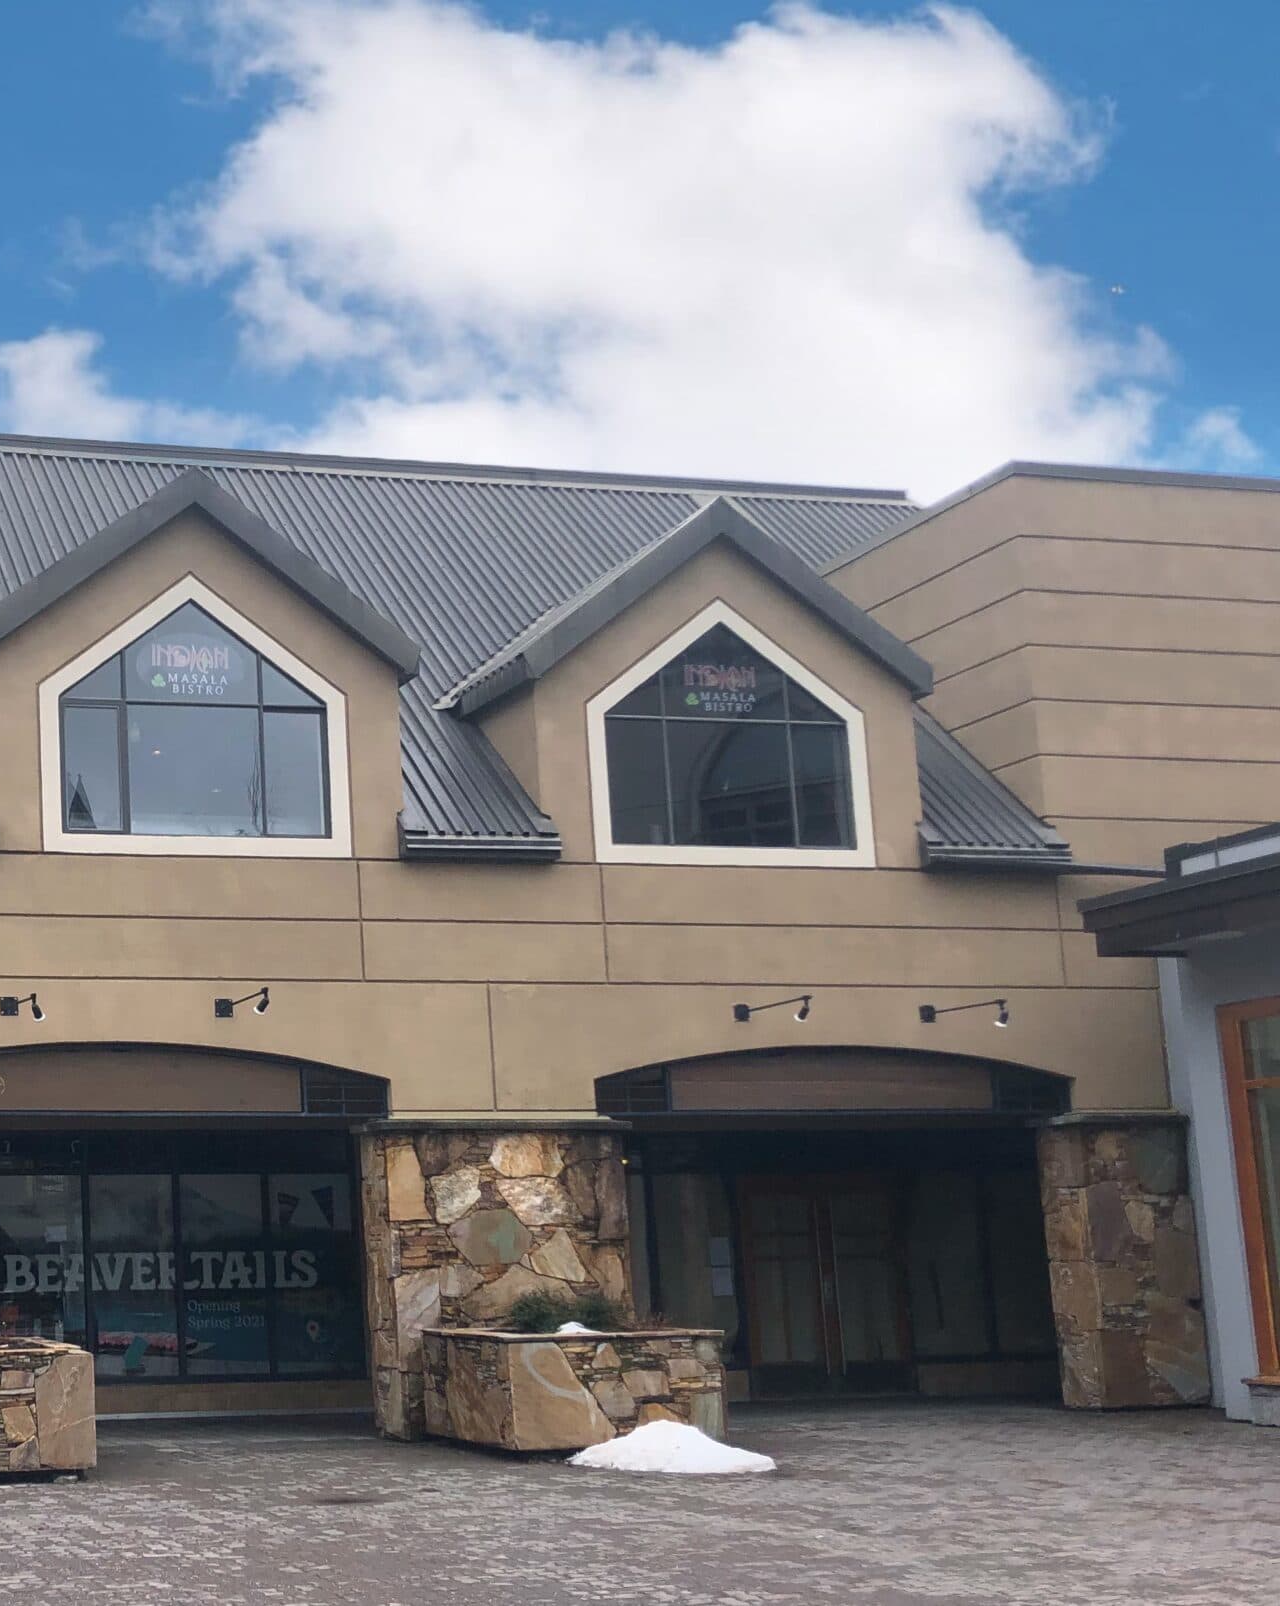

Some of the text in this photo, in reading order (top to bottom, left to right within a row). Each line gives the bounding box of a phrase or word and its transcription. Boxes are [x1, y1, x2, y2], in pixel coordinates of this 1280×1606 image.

[168, 673, 228, 685] MASALA
[172, 684, 224, 695] BISTRO
[700, 692, 756, 703] MASALA
[705, 702, 752, 713] BISTRO
[187, 1300, 240, 1313] Opening
[188, 1316, 231, 1330] Spring
